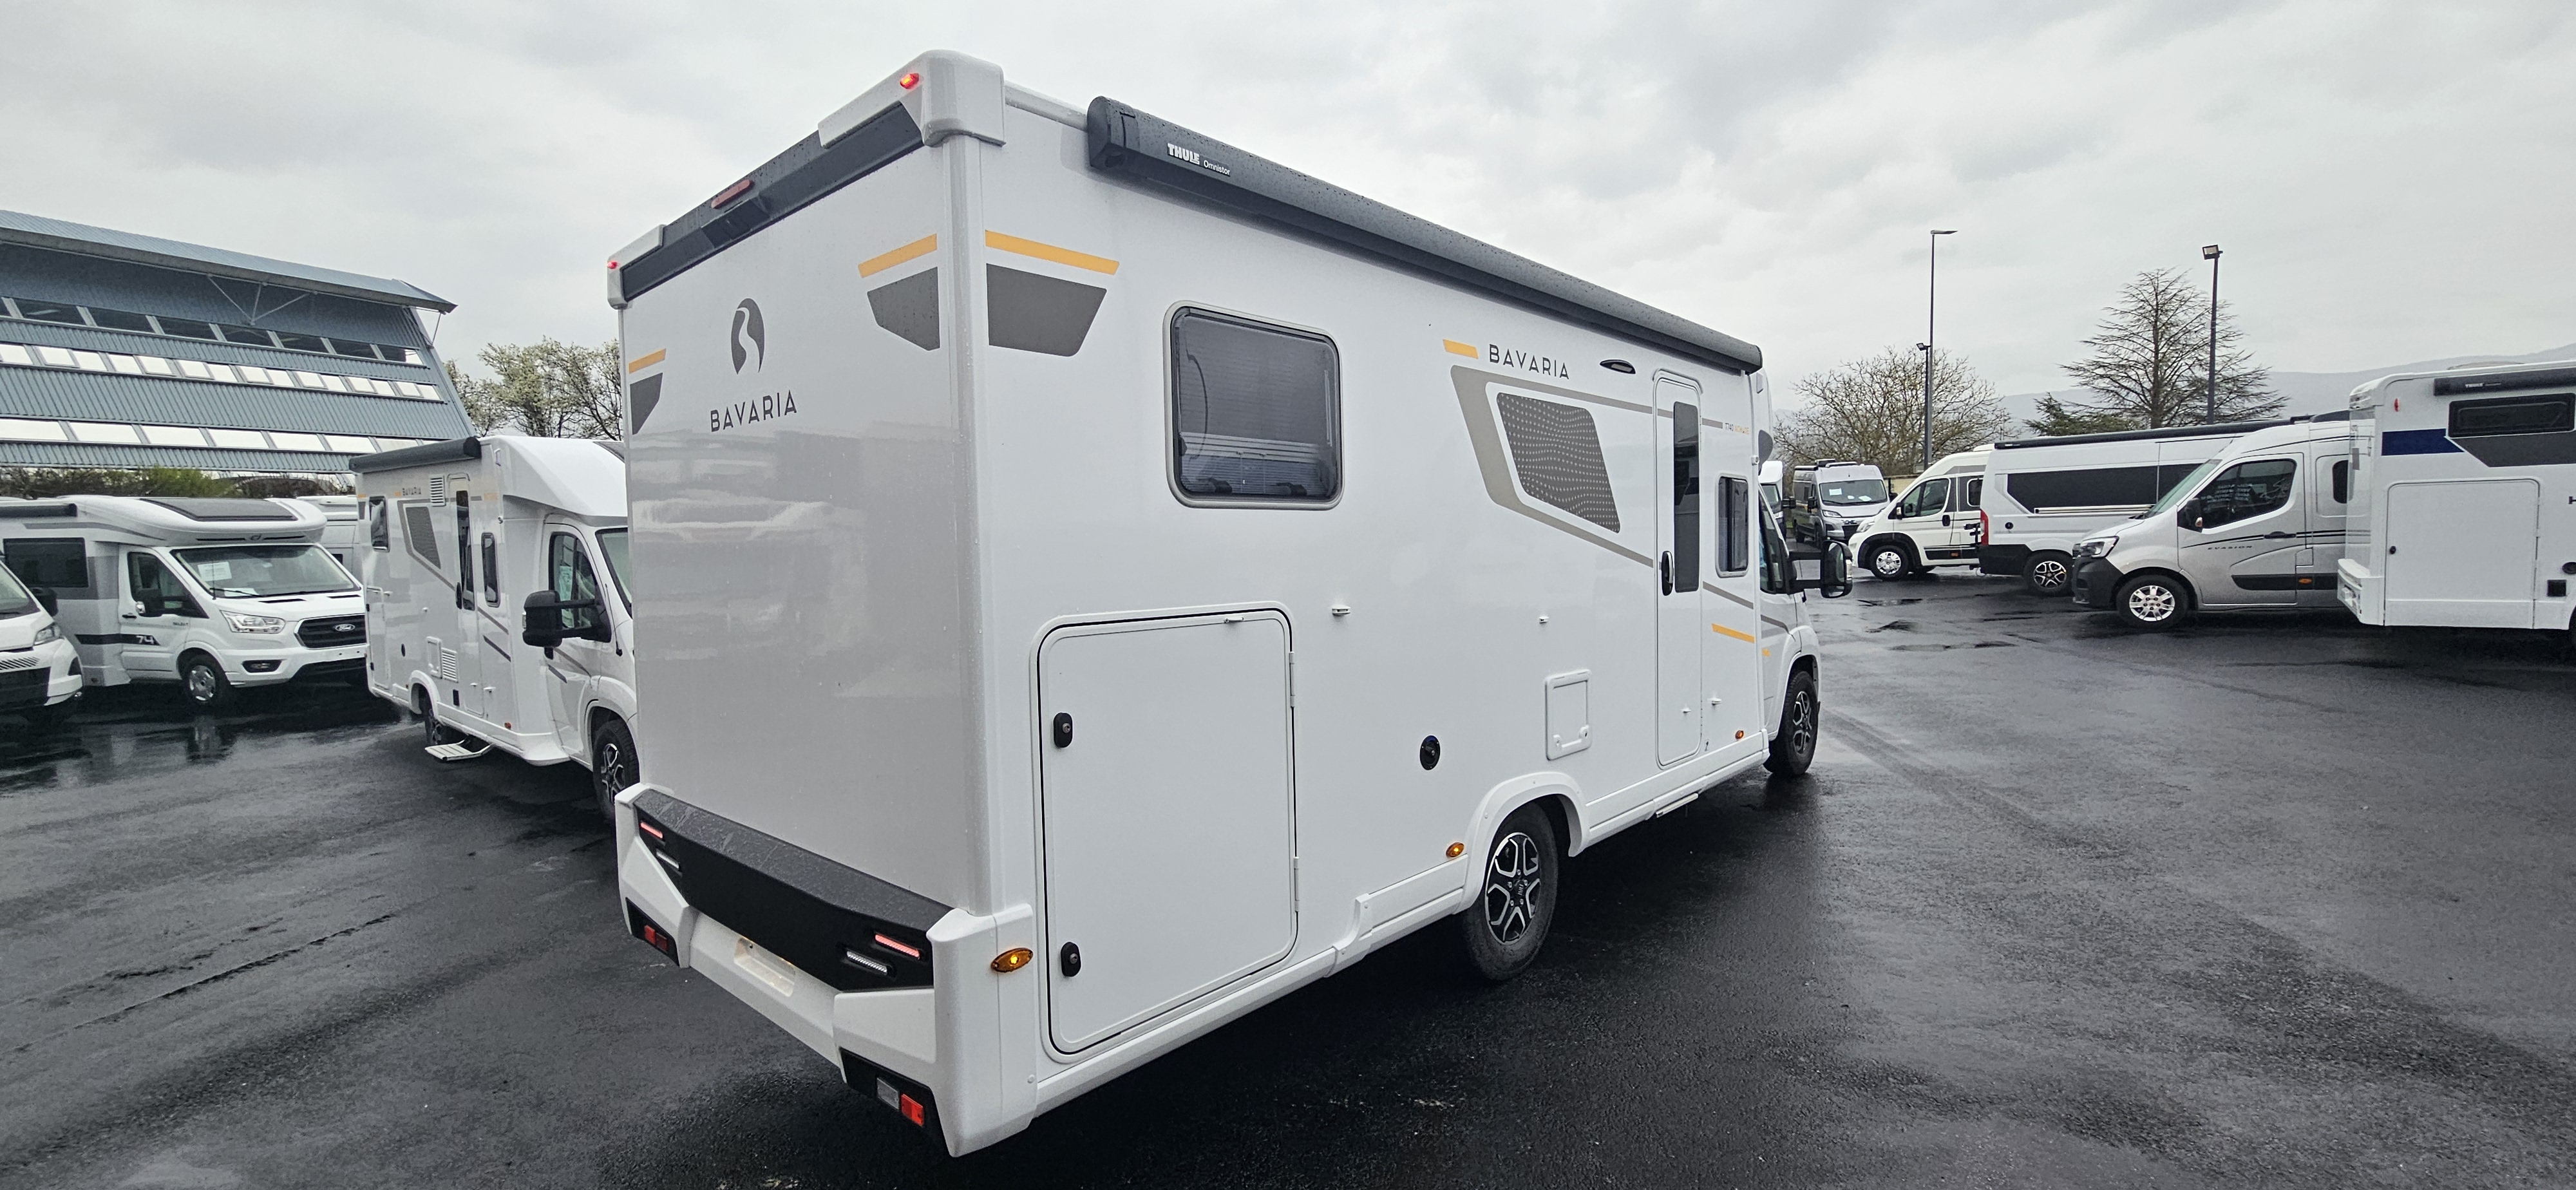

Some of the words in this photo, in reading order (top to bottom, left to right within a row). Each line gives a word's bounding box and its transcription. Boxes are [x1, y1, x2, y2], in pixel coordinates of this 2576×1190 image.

[1167, 143, 1200, 165] THULE
[1203, 160, 1231, 176] Omnistor
[1489, 343, 1569, 380] BAVARIA
[710, 389, 798, 433] BAVARIA
[136, 635, 155, 645] 74
